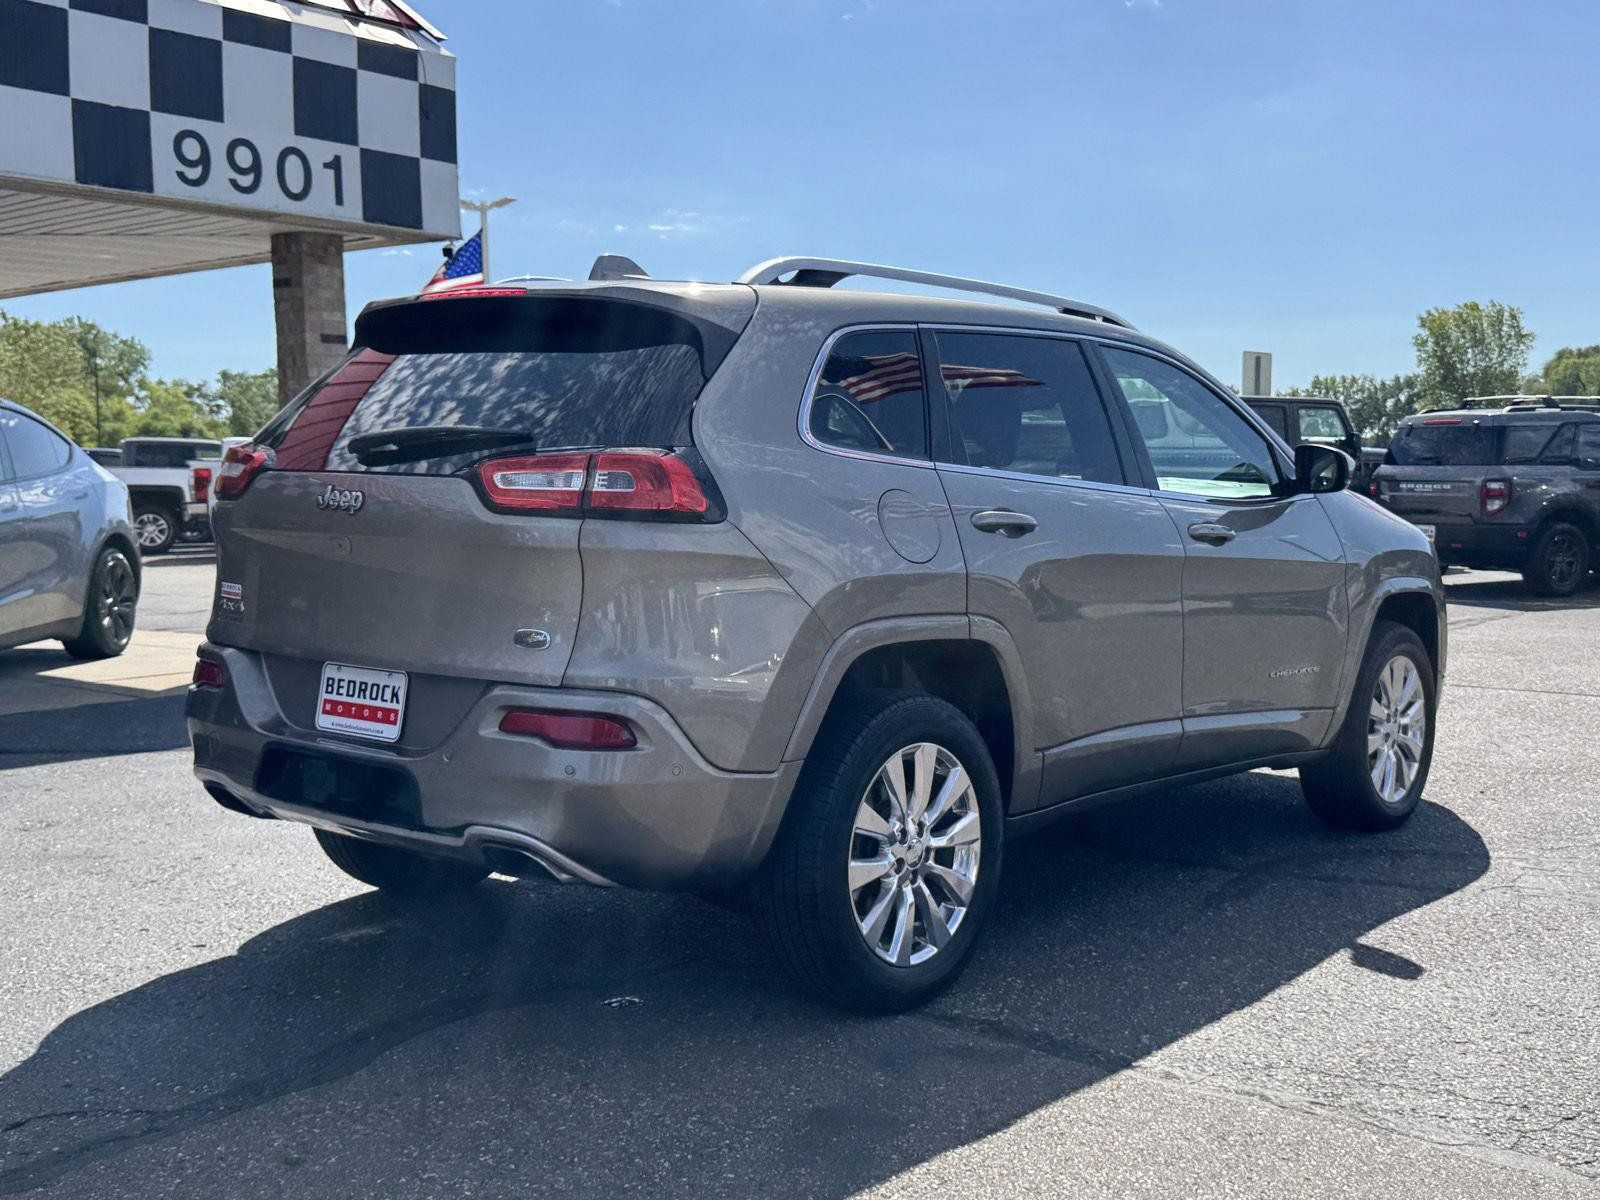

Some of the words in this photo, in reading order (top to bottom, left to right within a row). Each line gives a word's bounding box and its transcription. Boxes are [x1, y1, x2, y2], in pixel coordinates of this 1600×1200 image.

[173, 129, 344, 206] 9901
[317, 485, 363, 514] Jeep
[325, 677, 401, 704] BEDROCK
[325, 703, 396, 721] MOTORS
